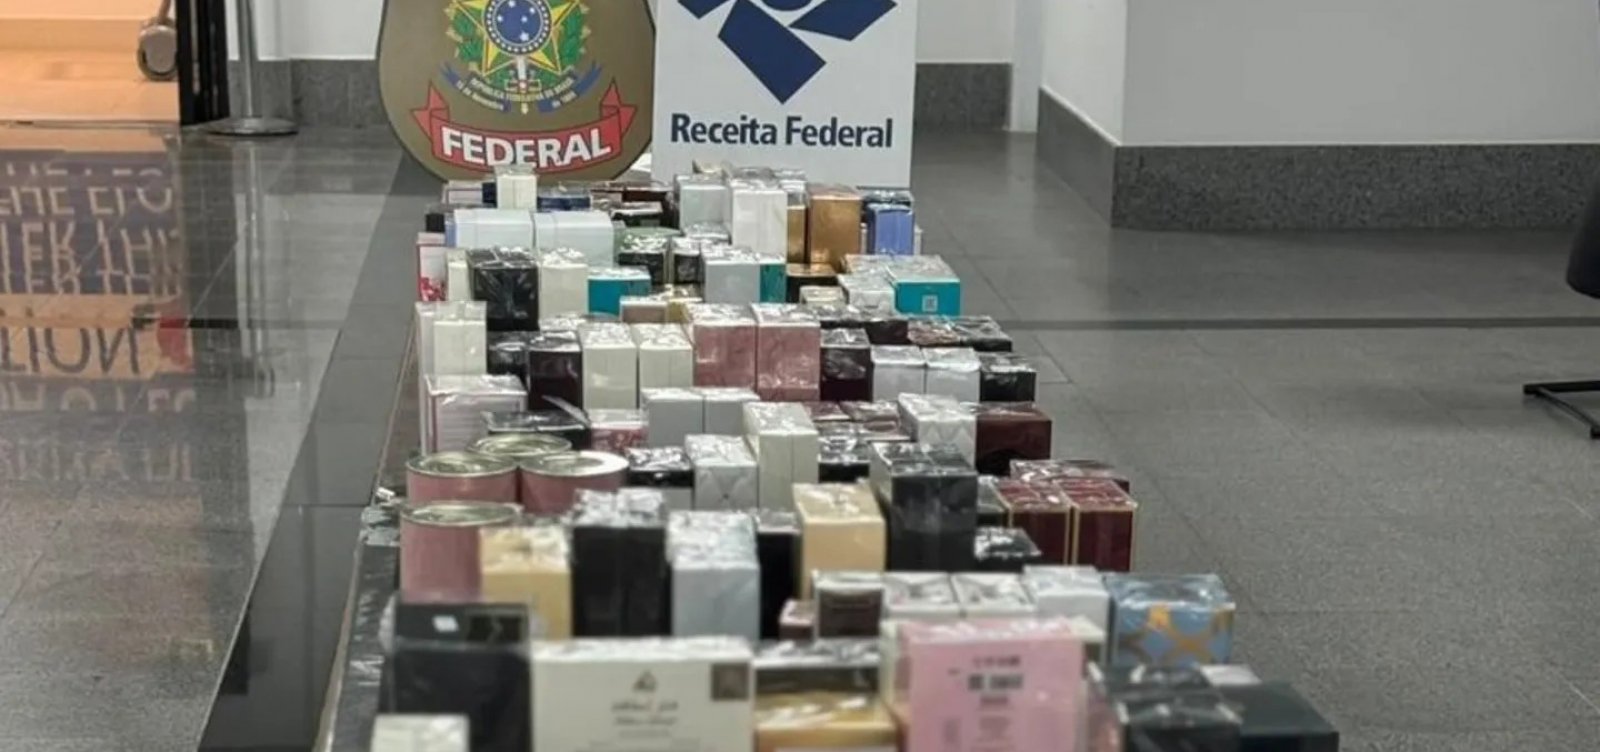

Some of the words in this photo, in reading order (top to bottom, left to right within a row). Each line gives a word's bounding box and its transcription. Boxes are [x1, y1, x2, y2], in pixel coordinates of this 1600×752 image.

[441, 126, 611, 169] FEDERAL
[671, 113, 778, 144] Receita
[785, 115, 893, 148] Federal
